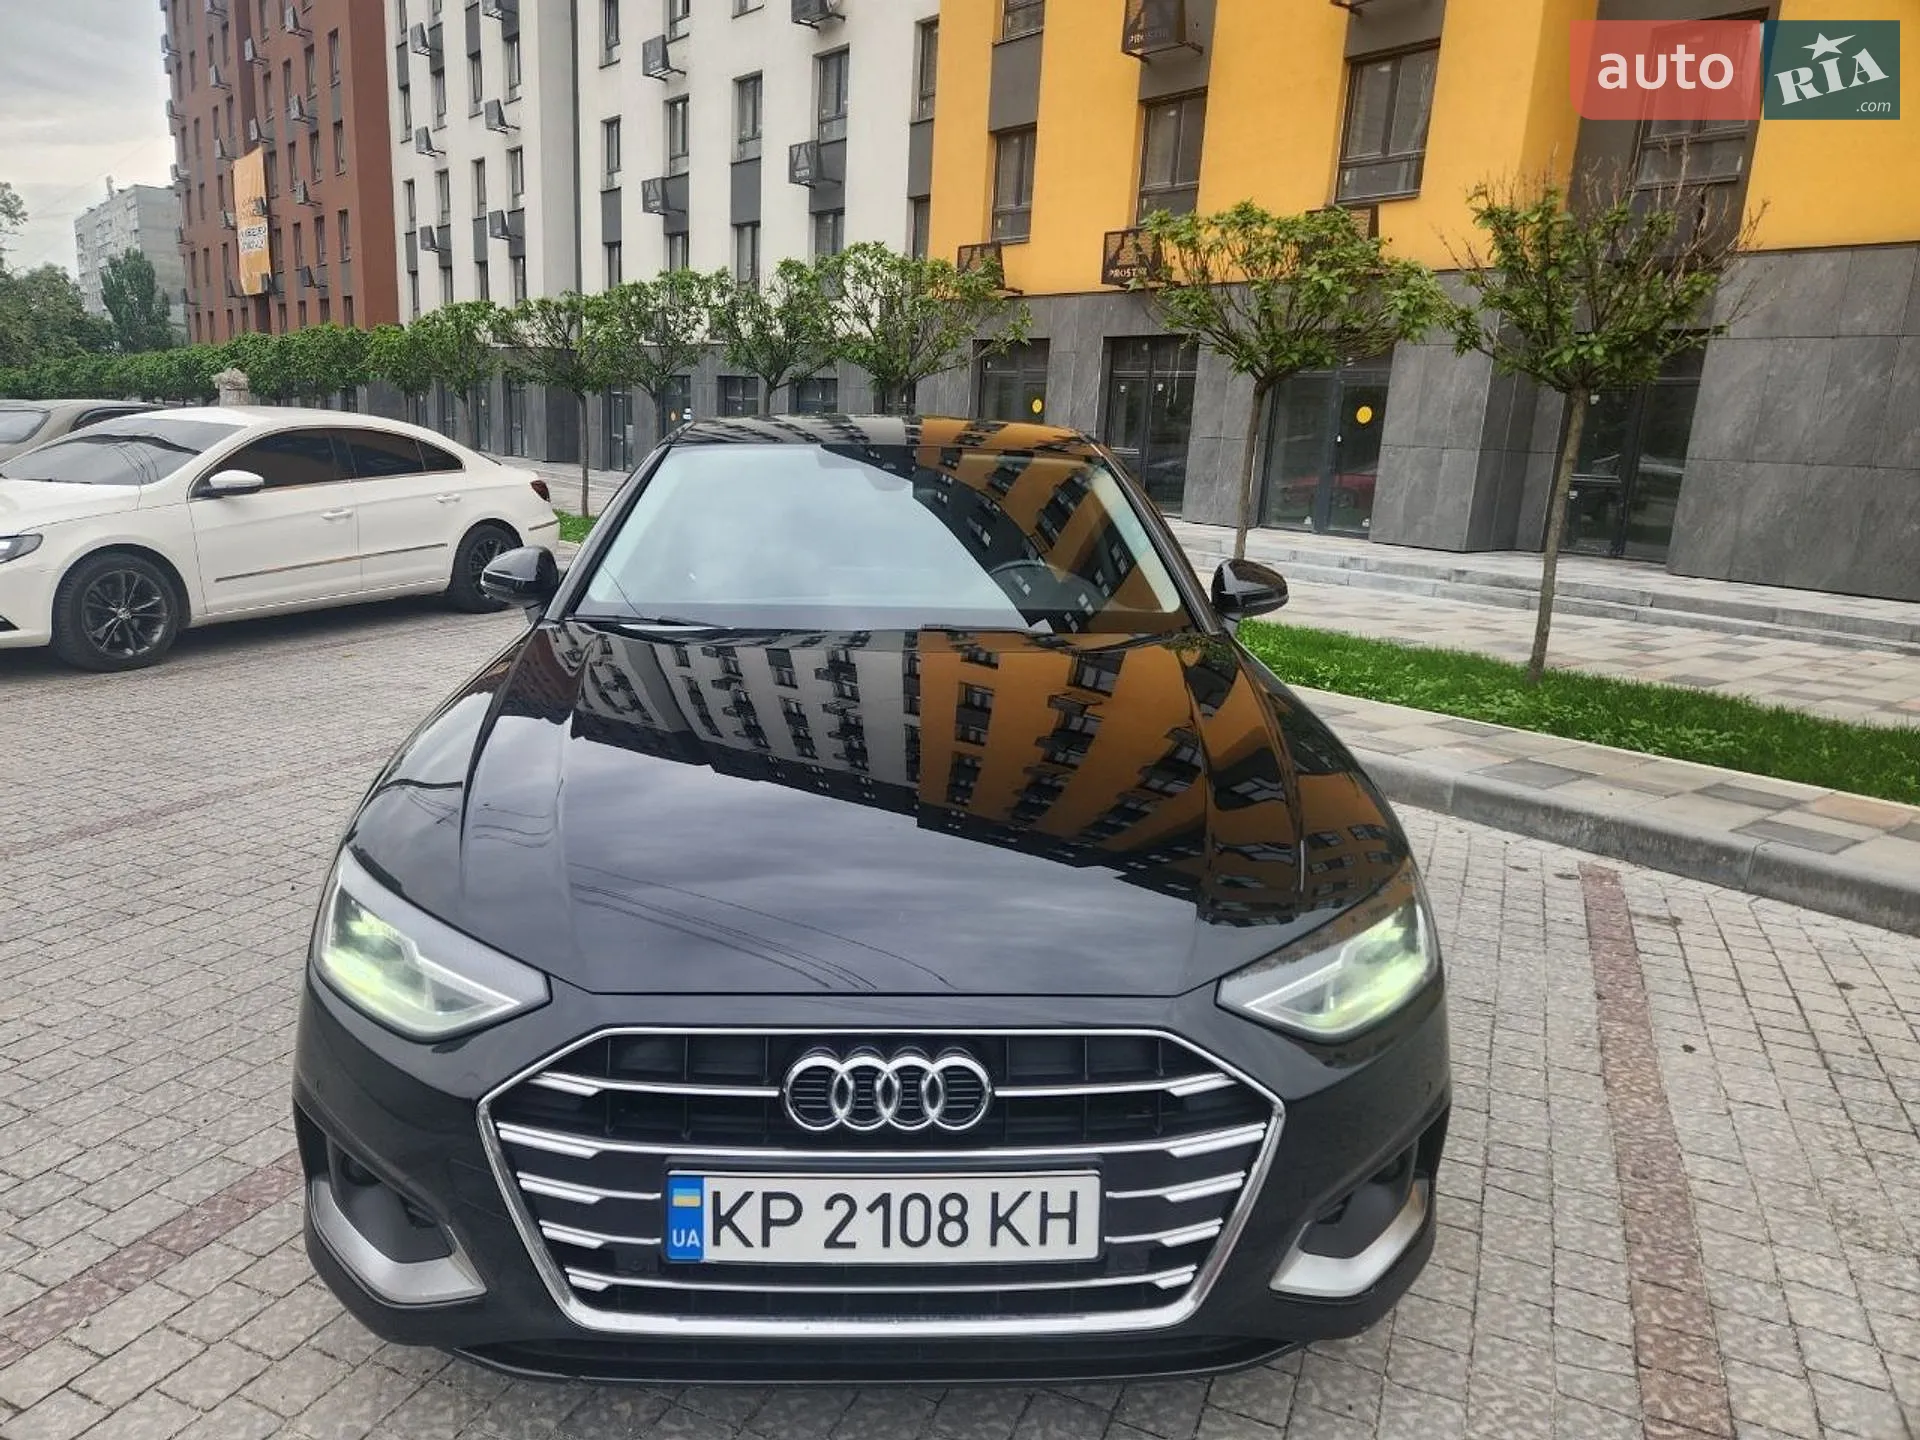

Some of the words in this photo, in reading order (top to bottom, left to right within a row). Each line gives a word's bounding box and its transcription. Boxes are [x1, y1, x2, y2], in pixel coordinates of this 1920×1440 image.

[672, 1229, 701, 1248] UA
[711, 1190, 803, 1249] KP
[823, 1191, 970, 1250] 2108
[989, 1190, 1079, 1248] KH
